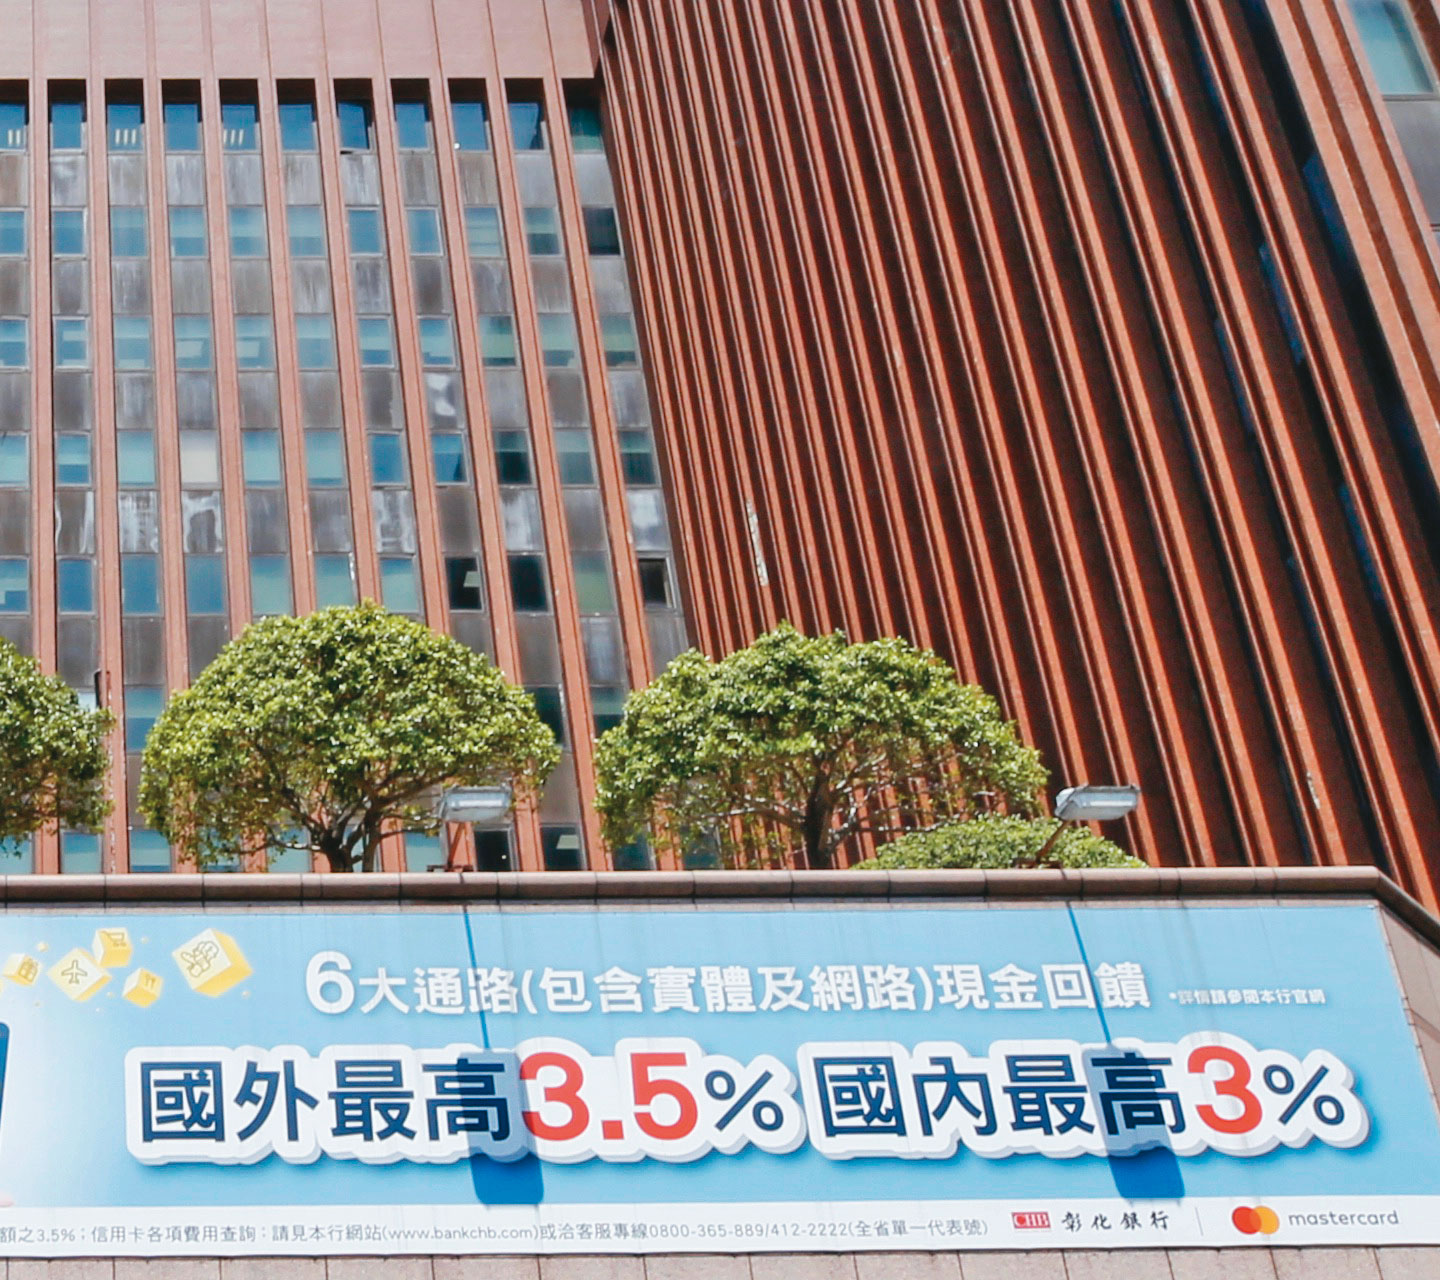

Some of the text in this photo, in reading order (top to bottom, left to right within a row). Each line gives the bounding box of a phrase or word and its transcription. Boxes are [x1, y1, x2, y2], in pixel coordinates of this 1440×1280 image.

[305, 950, 1151, 1014] 6大通路(包含實體及網路)現金回饋
[138, 1046, 1343, 1144] 國外最高3.5% 國內最高3%
[1012, 1212, 1051, 1229] CHB
[1061, 1210, 1170, 1231] 彰化銀行
[1288, 1210, 1400, 1227] mastercard
